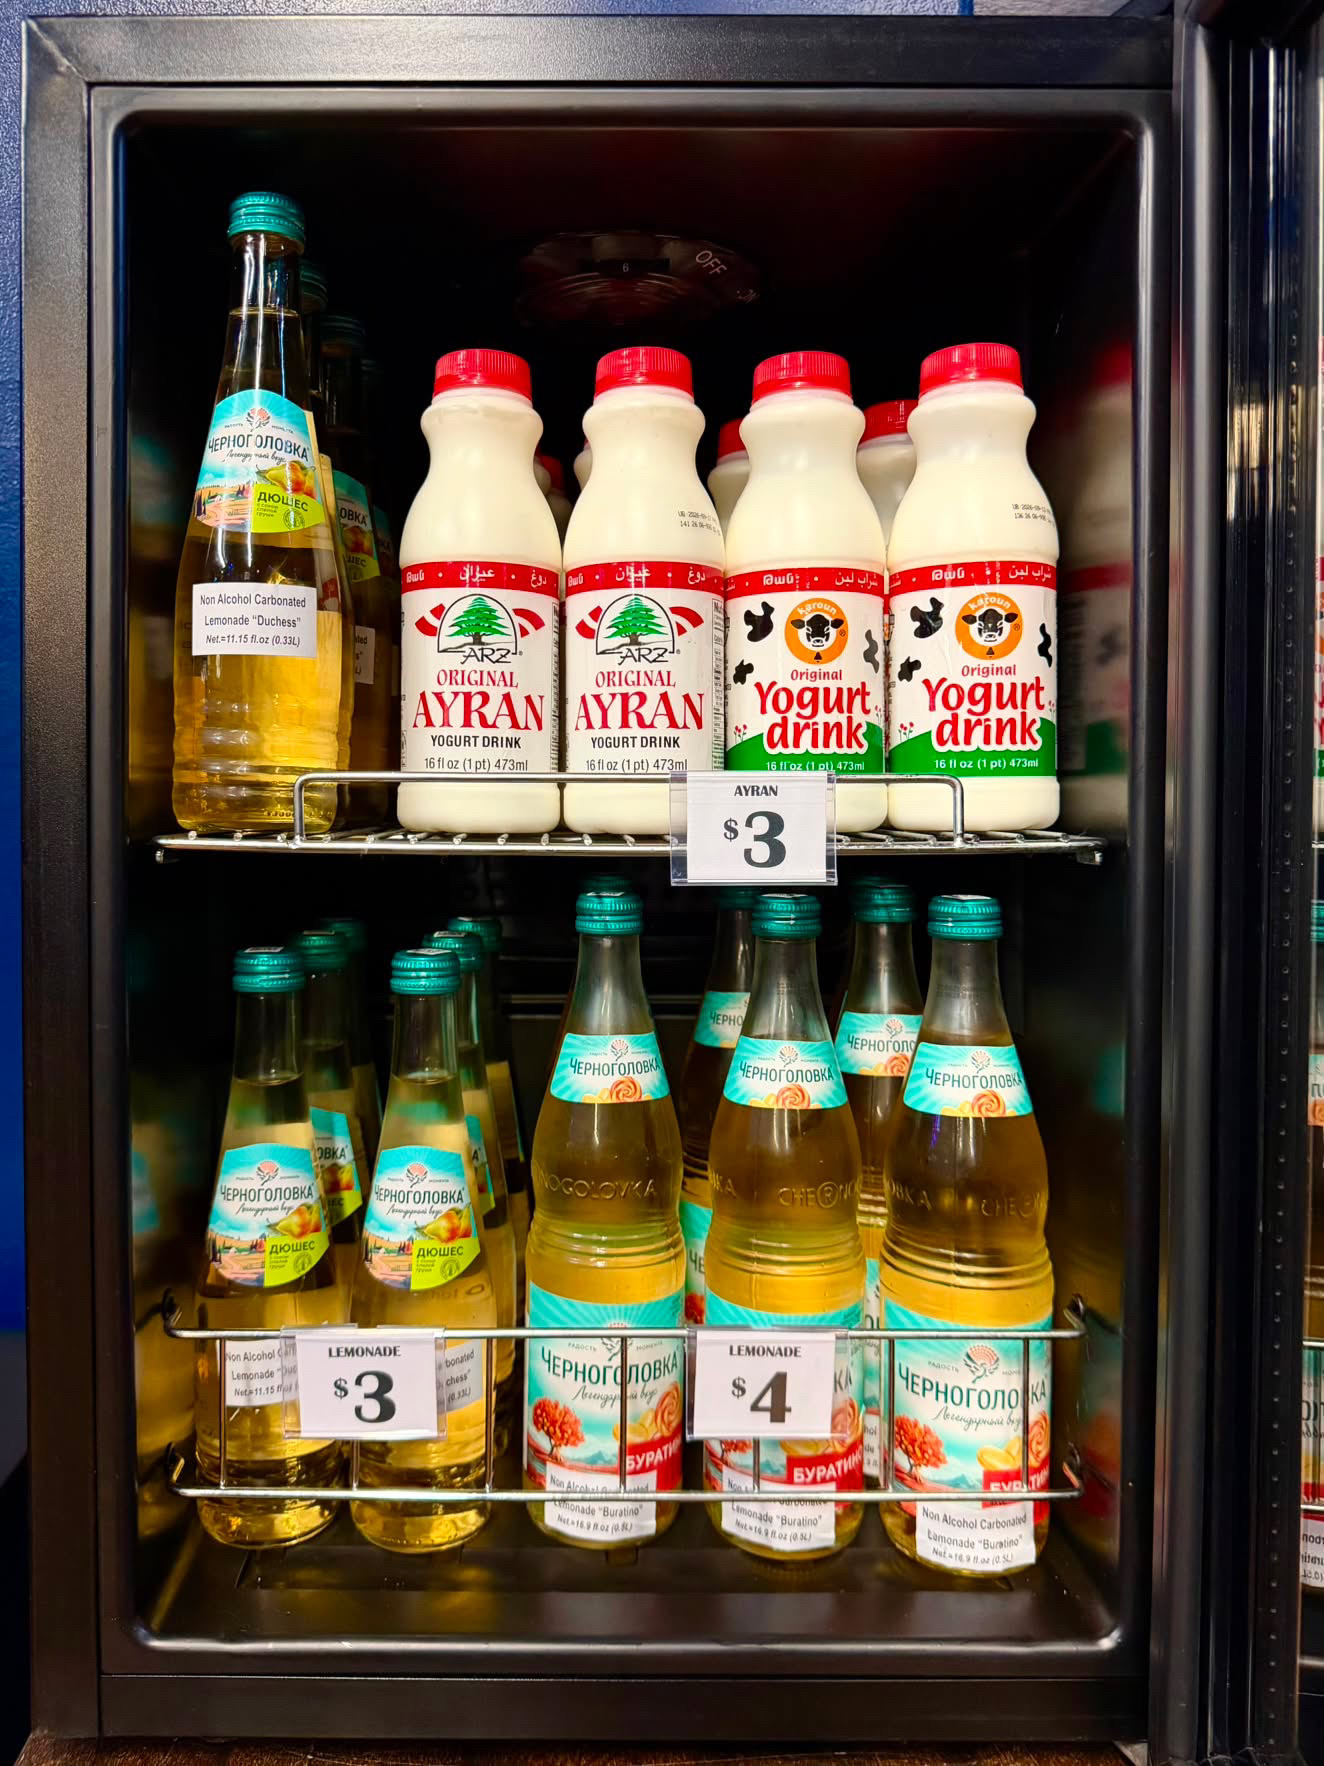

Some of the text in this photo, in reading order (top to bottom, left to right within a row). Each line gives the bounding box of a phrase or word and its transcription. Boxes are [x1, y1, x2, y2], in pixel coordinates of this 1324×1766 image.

[695, 250, 727, 275] OFF
[208, 434, 309, 462] ЧЕРНОГОЛОВКА
[257, 491, 309, 512] ДЮШЕС
[200, 594, 306, 609] Non Alcohol Carbonated
[204, 615, 301, 628] Lemonade “Duchess”
[271, 635, 301, 648] (0.33L)
[460, 646, 512, 665] ARZ
[617, 646, 670, 666] ARZ
[437, 669, 519, 688] ORIGINAL
[595, 670, 676, 688] ORIGINAL
[790, 669, 842, 682] Original
[961, 664, 1017, 678] Original
[754, 680, 871, 720] Yogurt
[922, 676, 1045, 716] Yogurt
[412, 690, 545, 732] AYRAN
[574, 691, 705, 731] AYRAN
[766, 715, 865, 749] drink
[936, 711, 1040, 746] drink
[430, 734, 522, 749] YOGURT DRINK
[591, 735, 680, 749] YOGURT DRINK
[424, 757, 435, 770] 16
[436, 757, 446, 770] fl
[446, 760, 460, 770] oz
[495, 758, 529, 771] 473ml
[586, 758, 596, 771] 16
[597, 758, 605, 771] fl
[606, 761, 619, 771] oz
[653, 758, 688, 771] 473ml
[766, 761, 777, 771] 16
[779, 761, 788, 771] fl
[789, 763, 802, 771] oz
[836, 761, 865, 771] 473ml
[934, 759, 945, 769] 16
[948, 759, 957, 769] fl
[959, 761, 974, 770] oz
[1009, 758, 1039, 769] 473ml
[734, 785, 778, 797] AYRAN
[723, 810, 787, 868] $3
[569, 1057, 661, 1076] ЧЕРНОГОЛОВКА
[739, 1060, 834, 1083] ЧЕРНОГОЛОВКА
[925, 1067, 1022, 1090] ЧЕРНОГОЛОВКА
[220, 1184, 314, 1202] ЧЕРНОГОЛОВКА
[374, 1184, 464, 1204] ЧЕРНОГОЛОВКА
[269, 1240, 316, 1255] ДЮШЕС
[416, 1246, 464, 1259] ДЮШЕС
[243, 1349, 276, 1362] Alcohol
[328, 1345, 402, 1358] LEMONADE
[729, 1344, 802, 1358] LEMONADE
[231, 1368, 275, 1381] Lemonade
[898, 1362, 1046, 1410] ЧЕРНОГОЛОКА
[333, 1370, 396, 1424] $3
[731, 1371, 792, 1424] $4
[922, 1506, 1027, 1530] Non Alcohol Carbonated
[927, 1528, 975, 1549] Lemonade
